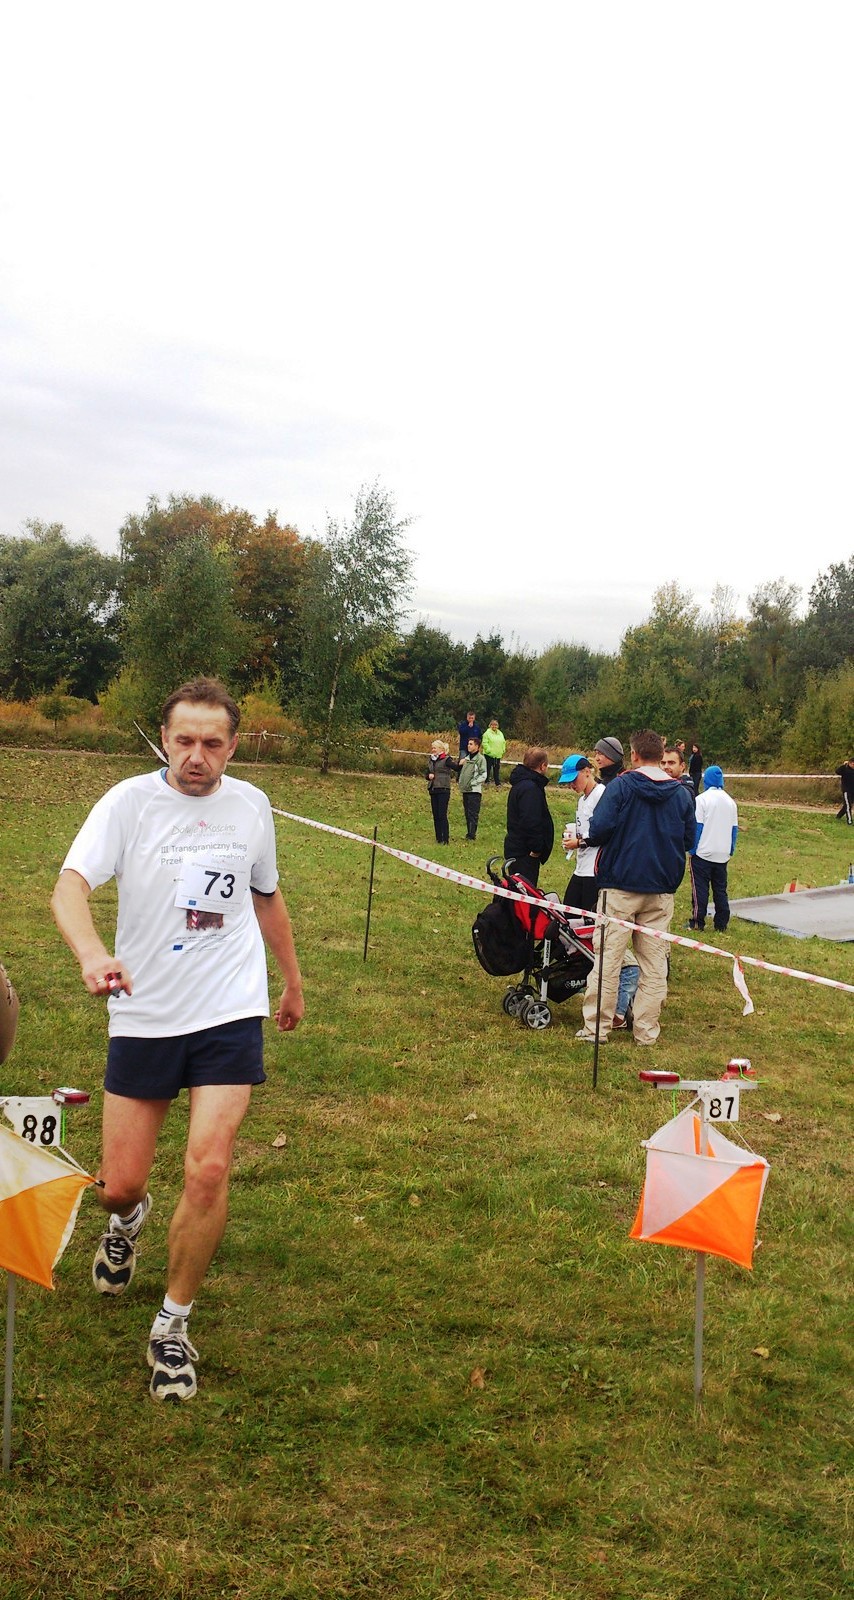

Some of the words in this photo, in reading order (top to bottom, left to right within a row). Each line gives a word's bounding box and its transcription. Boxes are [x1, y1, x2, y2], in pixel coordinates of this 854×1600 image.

[171, 842, 231, 853] Transgraniczny
[232, 841, 248, 852] Bieg
[204, 870, 236, 899] 73
[709, 1096, 734, 1119] 87
[22, 1114, 57, 1145] 88
